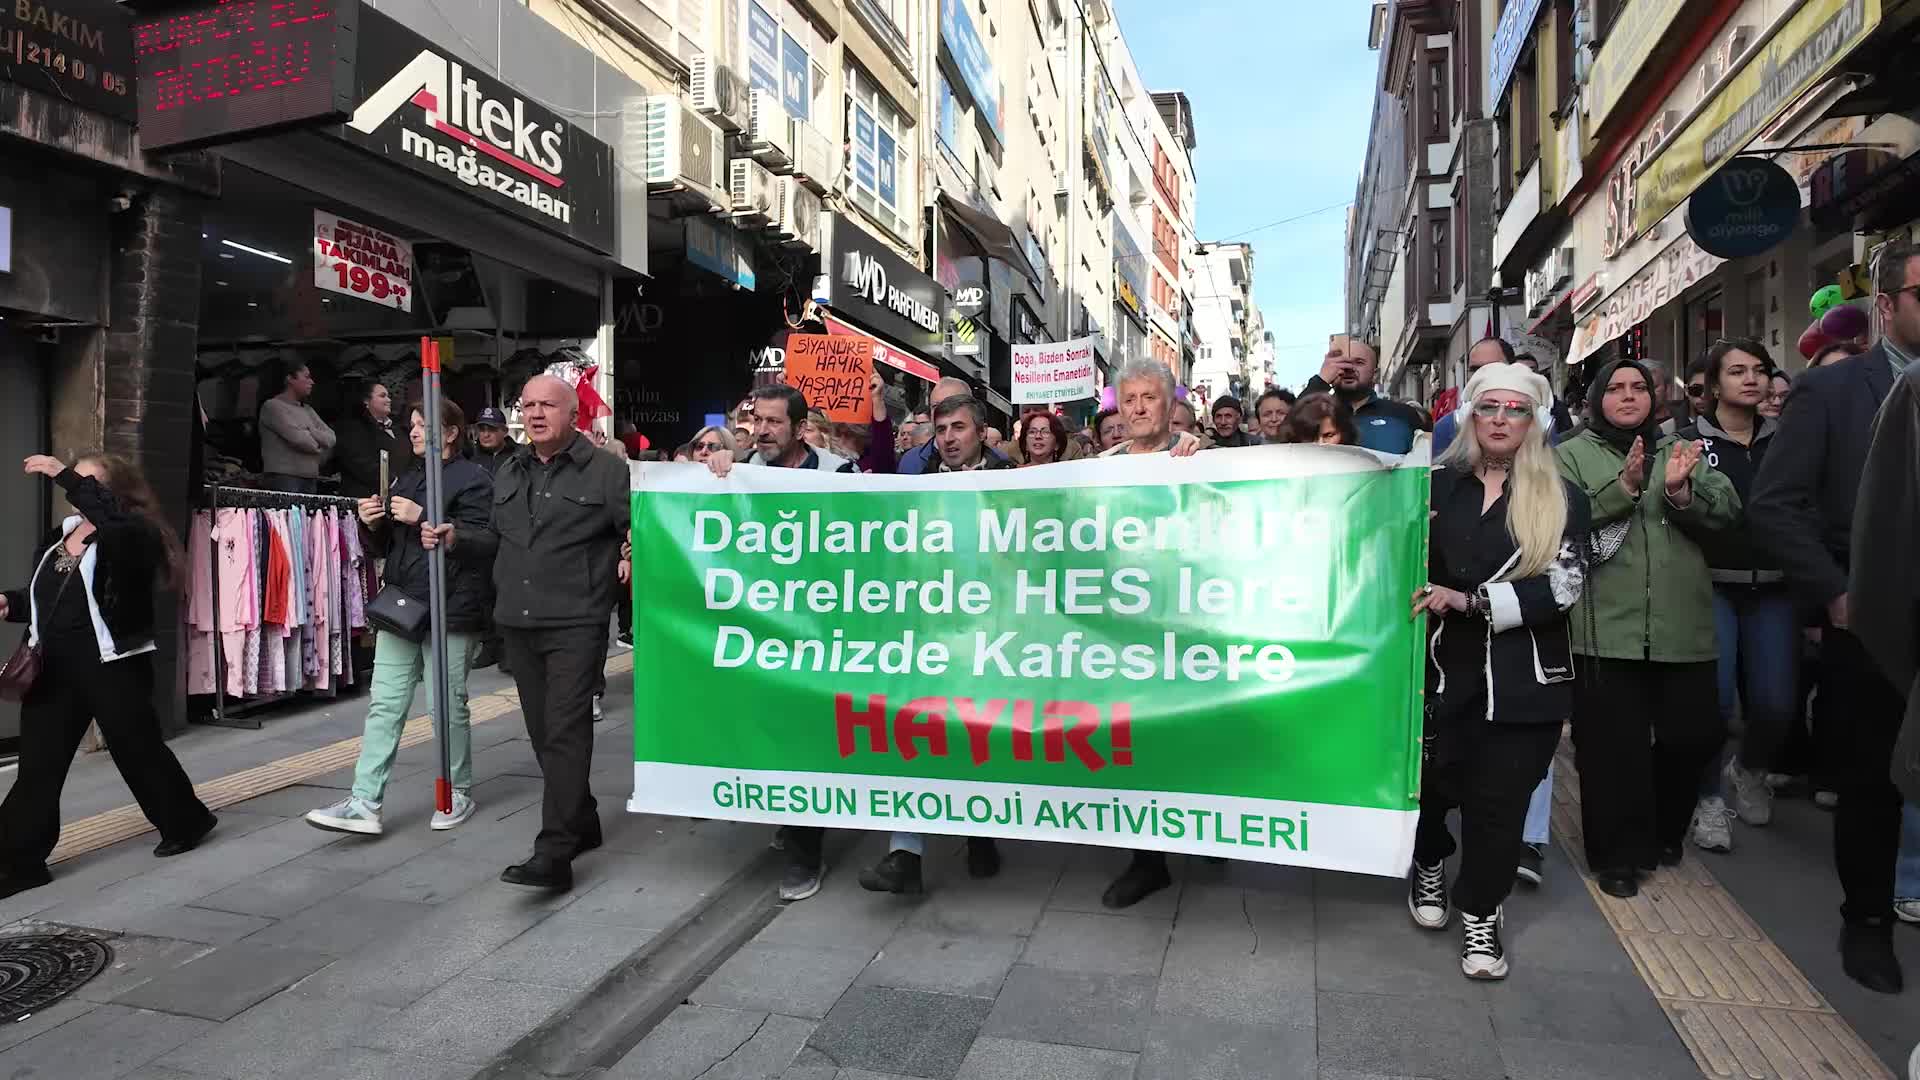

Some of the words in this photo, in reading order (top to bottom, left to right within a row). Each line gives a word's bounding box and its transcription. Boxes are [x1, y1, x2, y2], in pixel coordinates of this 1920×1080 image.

[16, 0, 105, 56] BAKIM
[345, 49, 563, 175] Alteks
[888, 284, 940, 335] PARFUMEUR
[955, 286, 984, 302] MAD
[795, 374, 865, 397] YAŞAMA
[815, 355, 866, 375] HAYIR
[811, 395, 865, 412] EVET
[692, 509, 954, 565] Dağlarda
[704, 567, 992, 615] Derelerde
[1015, 567, 1151, 615] HES
[713, 625, 950, 675] Denizde
[972, 631, 1297, 682] Kafeslere
[834, 692, 1134, 773] HAYIR!
[712, 776, 857, 816] GİRESUN
[869, 789, 1023, 826] EKOLOJİ
[1033, 796, 1309, 851] AKTİVİSTLERİ
